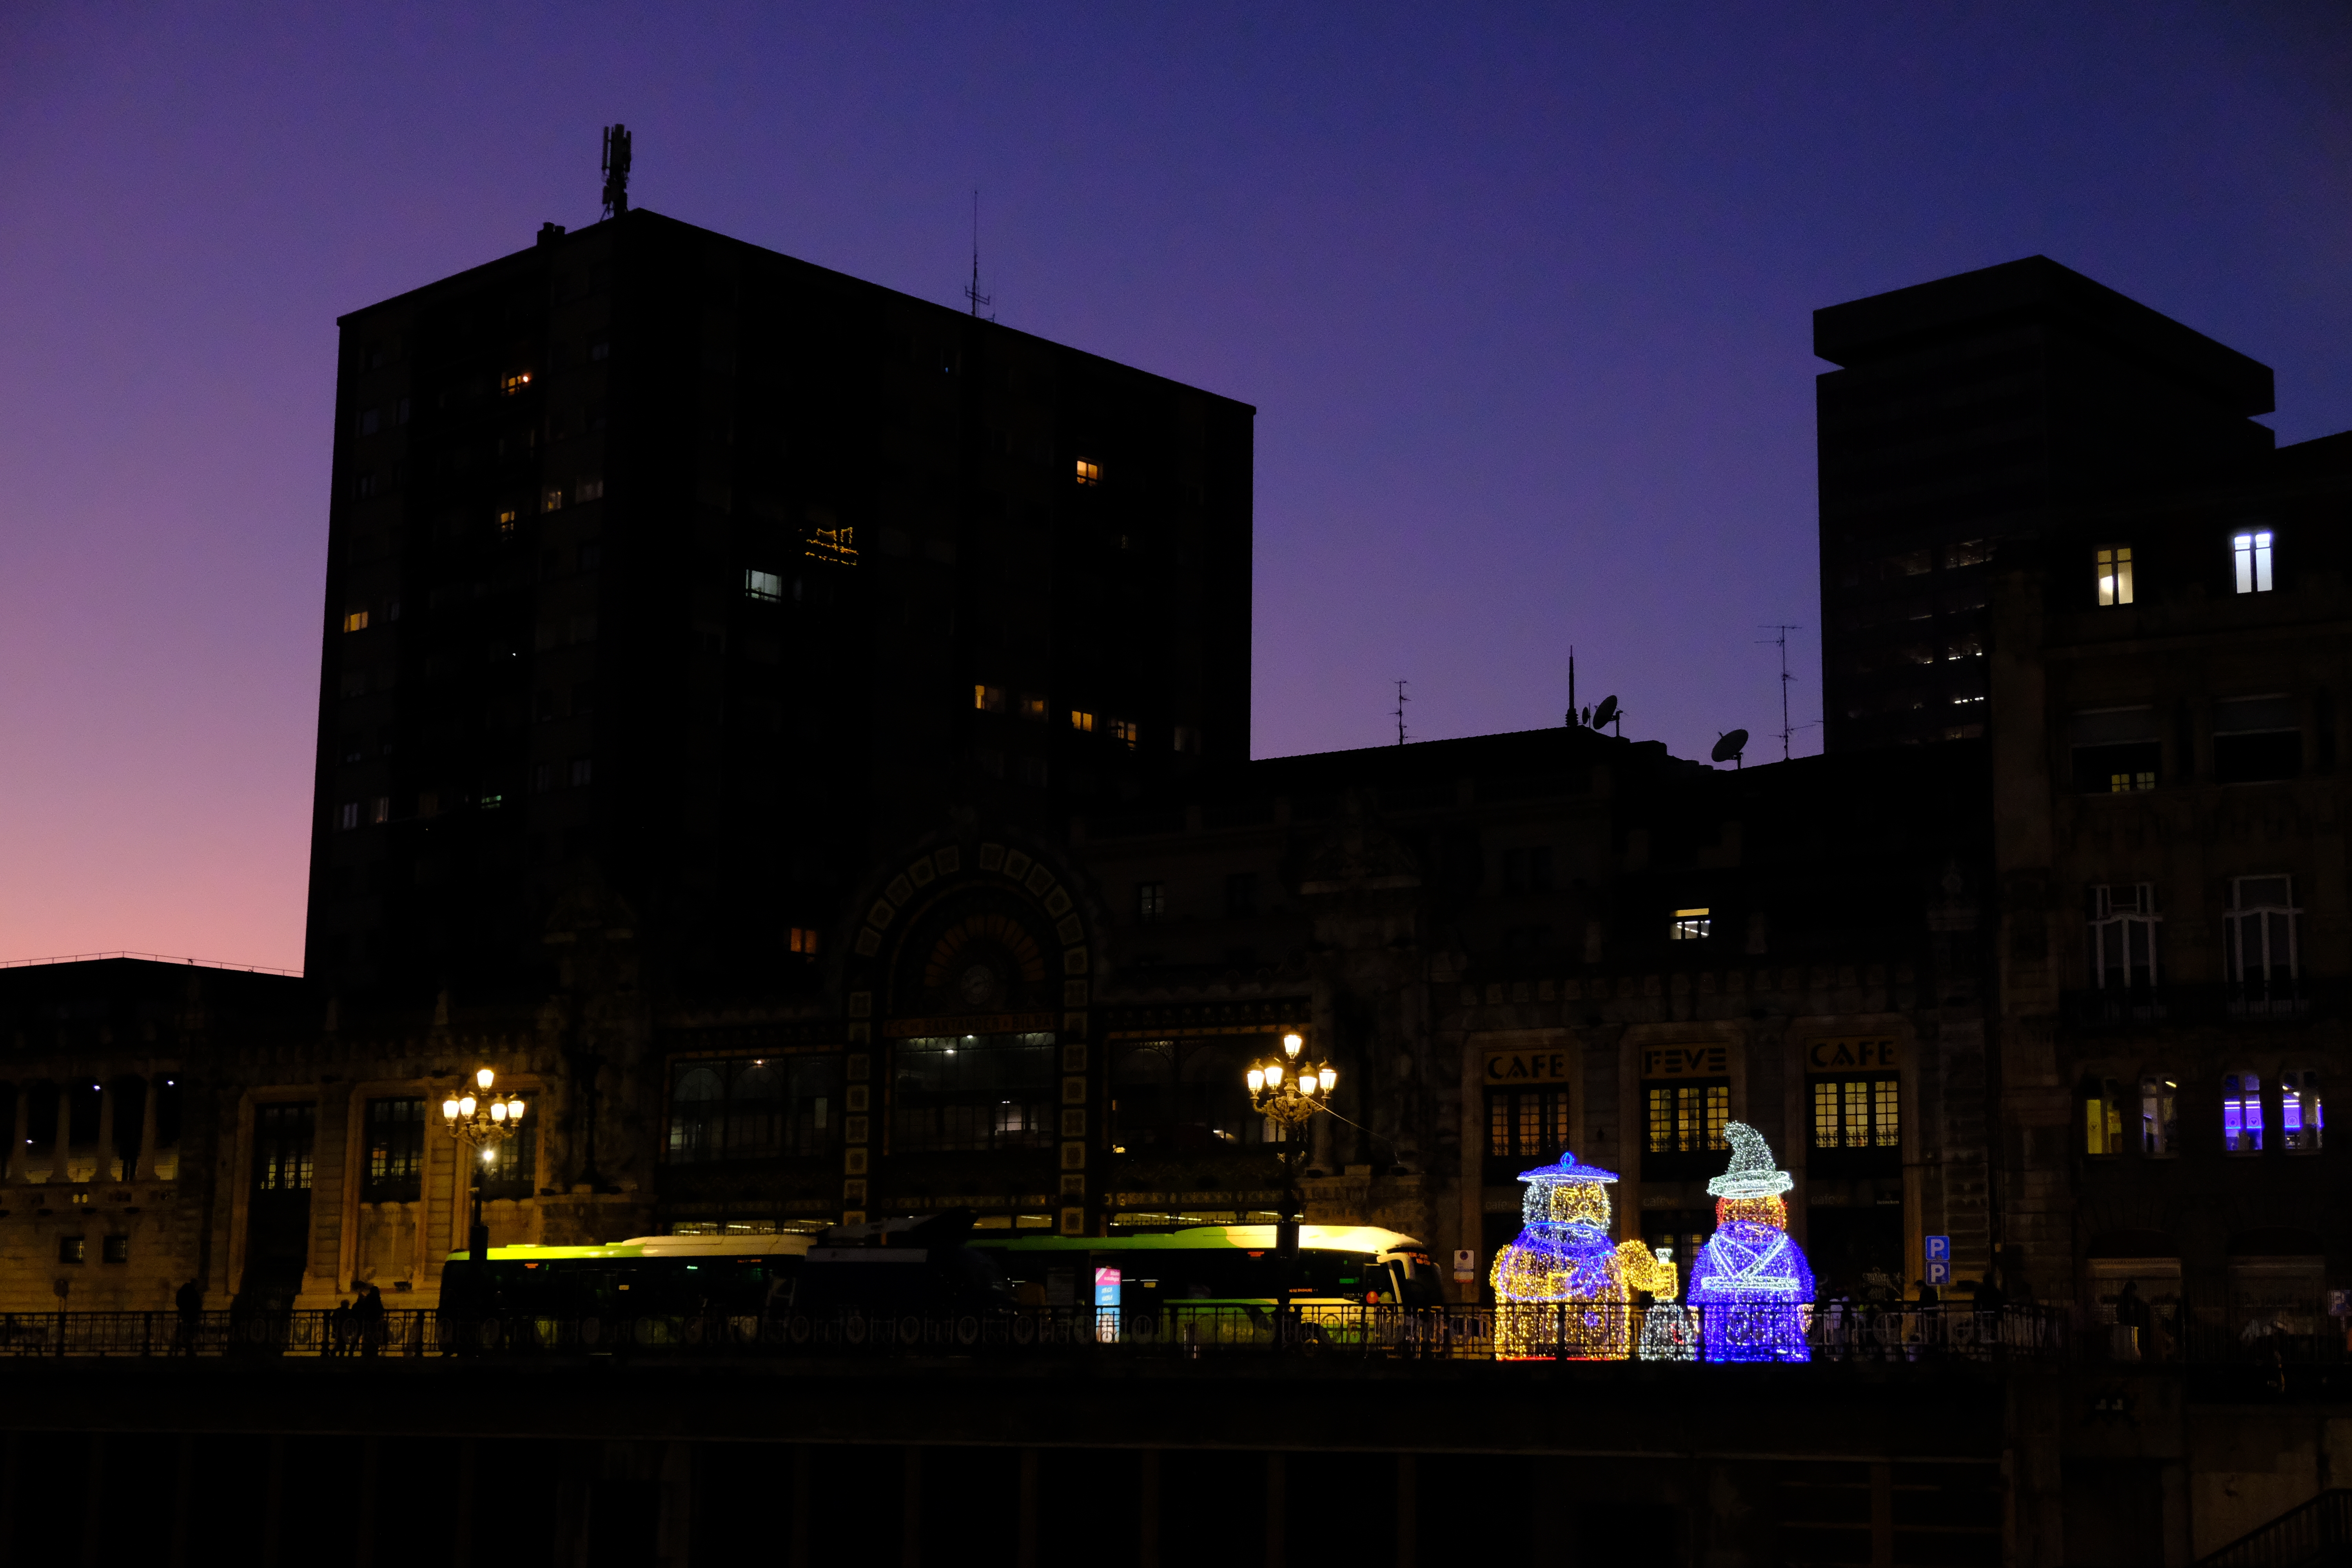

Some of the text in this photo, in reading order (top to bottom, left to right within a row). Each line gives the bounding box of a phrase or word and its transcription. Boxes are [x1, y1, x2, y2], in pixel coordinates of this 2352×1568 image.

[1488, 1053, 1564, 1079] CAFE
[1645, 1047, 1726, 1074] FEVE
[1810, 1041, 1895, 1067] CAFE
[1931, 1239, 1945, 1257] P
[1931, 1264, 1945, 1283] P
